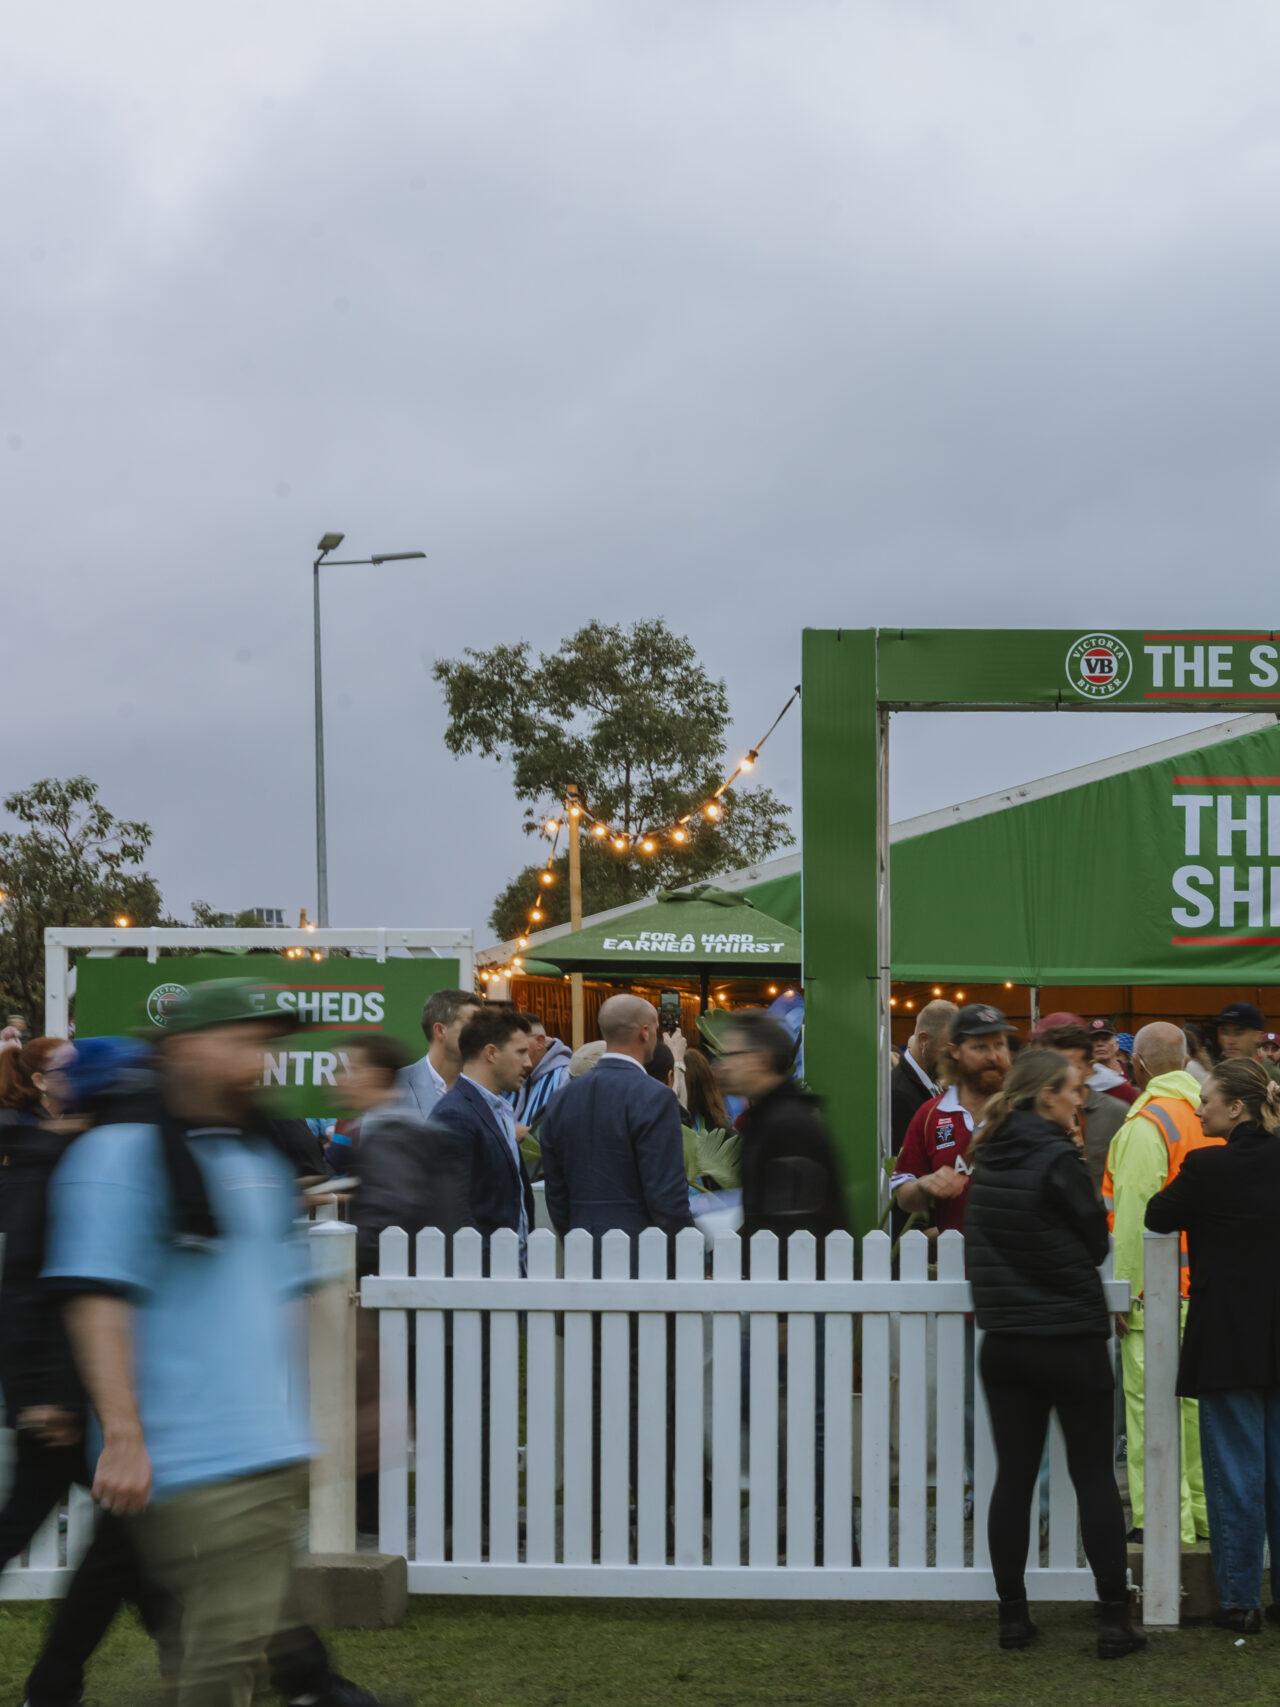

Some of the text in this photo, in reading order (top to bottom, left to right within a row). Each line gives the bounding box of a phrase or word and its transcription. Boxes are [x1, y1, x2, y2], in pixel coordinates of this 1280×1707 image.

[1073, 638, 1125, 660] VICTORIA
[1085, 658, 1114, 675] VB
[1143, 645, 1233, 687] THE
[1077, 678, 1122, 695] BITTER
[603, 938, 785, 953] EARNED THIRST
[639, 932, 754, 943] FOR A HARD
[256, 1051, 353, 1087] NTR
